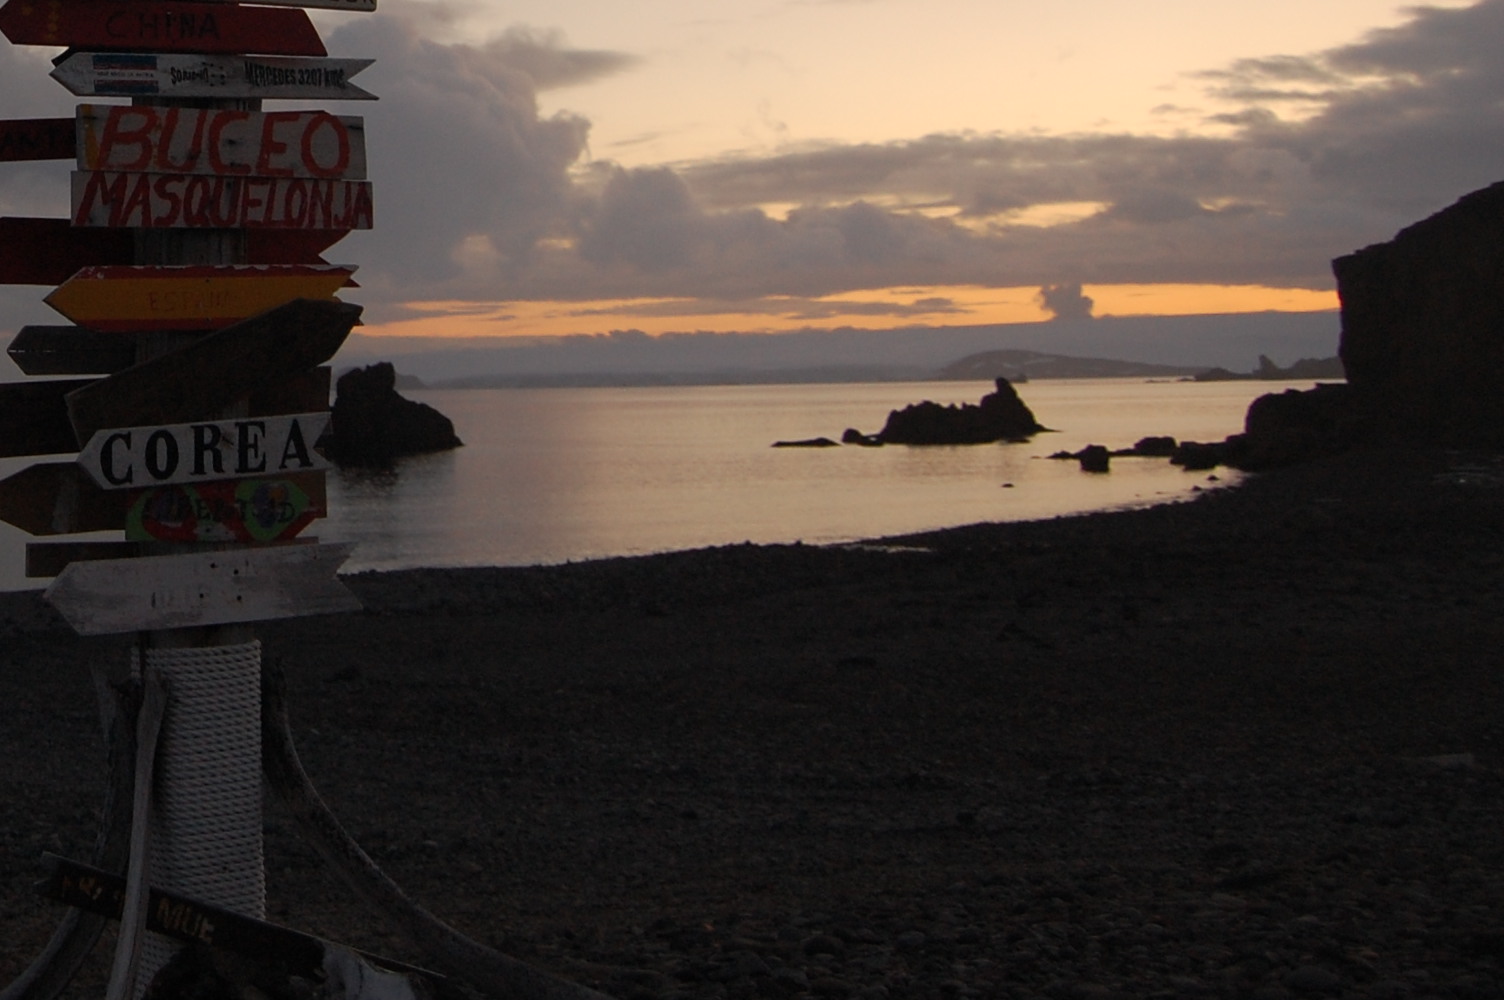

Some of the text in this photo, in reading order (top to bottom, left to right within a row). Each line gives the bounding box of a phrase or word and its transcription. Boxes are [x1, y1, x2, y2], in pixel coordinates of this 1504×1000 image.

[105, 11, 220, 40] CHINA
[244, 60, 296, 87] MERCEDES
[297, 68, 323, 86] 3207
[97, 105, 351, 179] BUCEO
[99, 419, 314, 486] COREA
